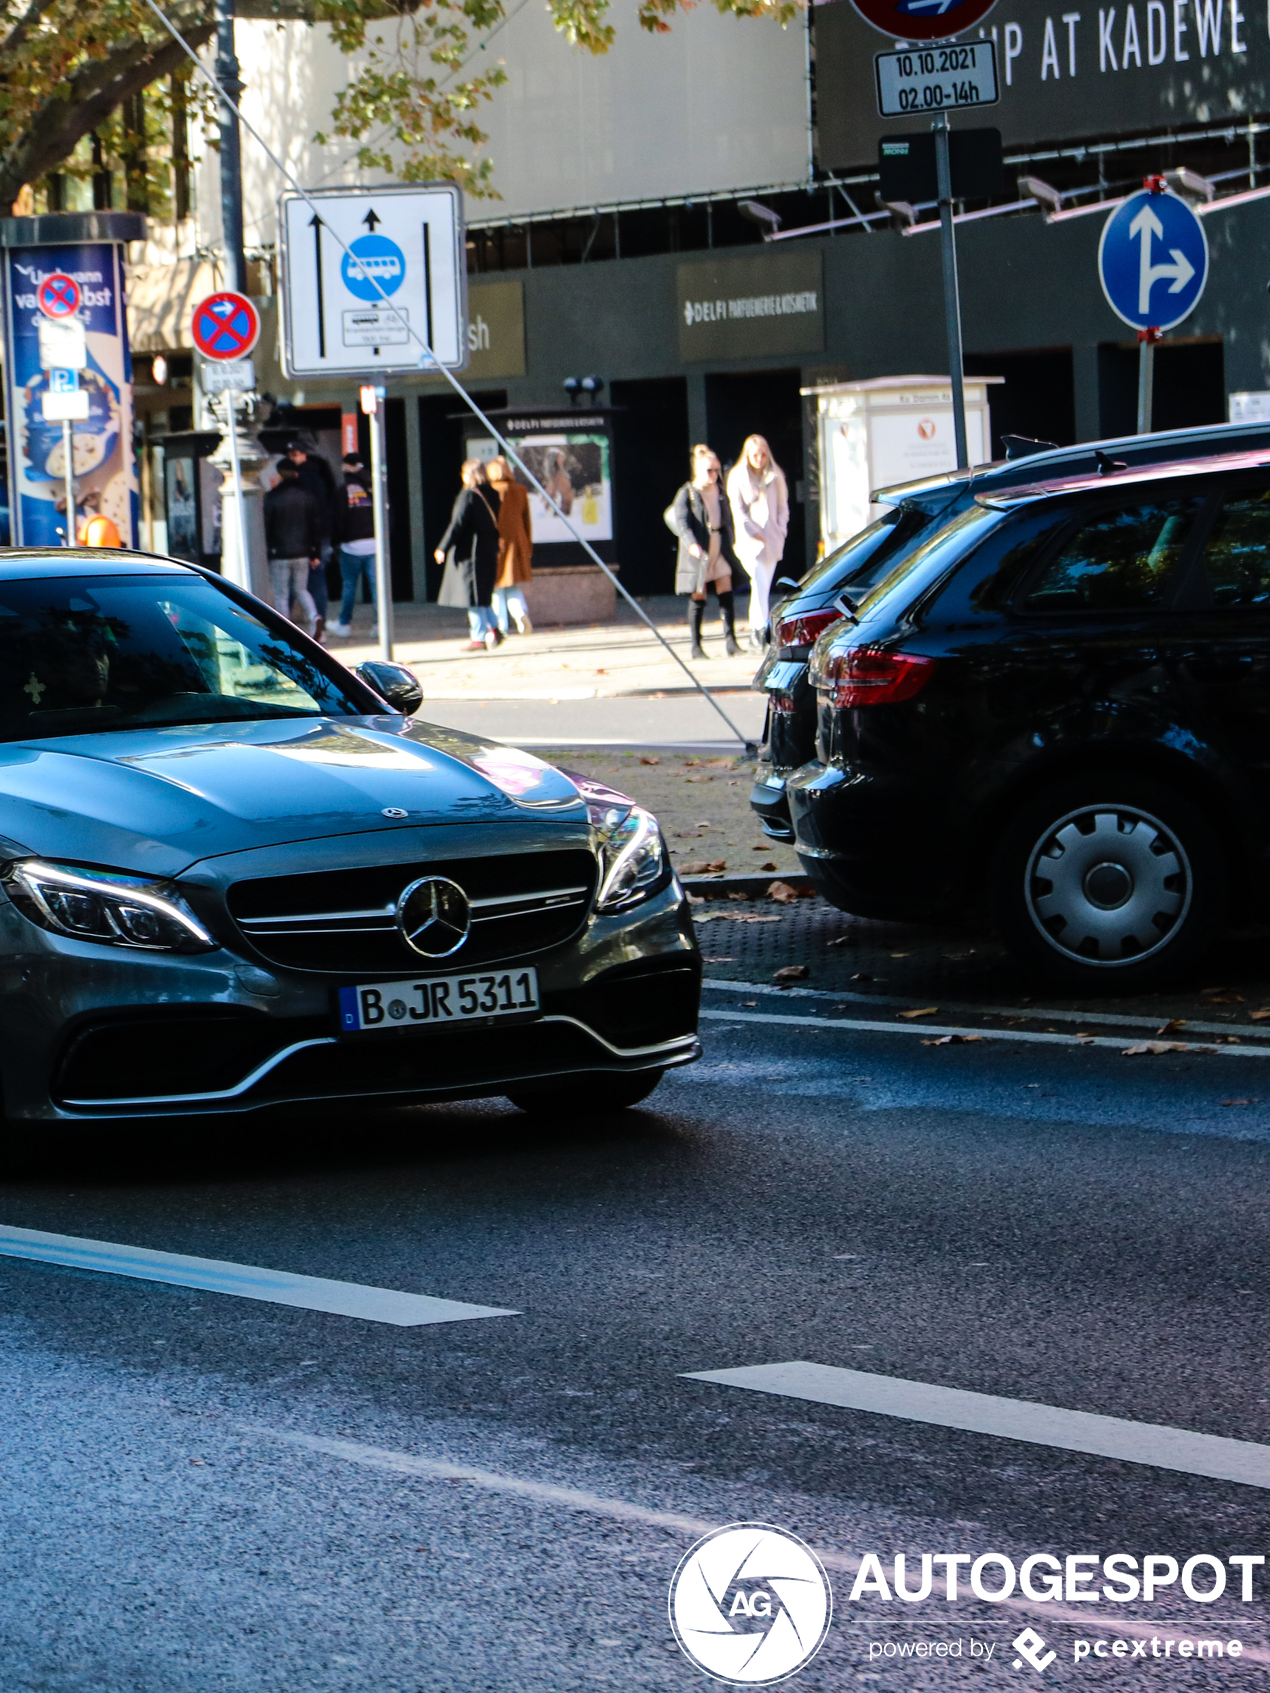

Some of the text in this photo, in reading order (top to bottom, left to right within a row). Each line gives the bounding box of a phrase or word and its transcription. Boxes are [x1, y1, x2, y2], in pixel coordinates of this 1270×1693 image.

[1041, 12, 1081, 81] AT
[1098, 0, 1248, 73] KADEWE
[895, 47, 977, 78] 10.10.2021
[898, 81, 980, 111] 02.00-14h
[694, 300, 727, 322] DELFI
[360, 988, 385, 1025] B
[409, 981, 453, 1020] JR
[458, 972, 536, 1015] 5311
